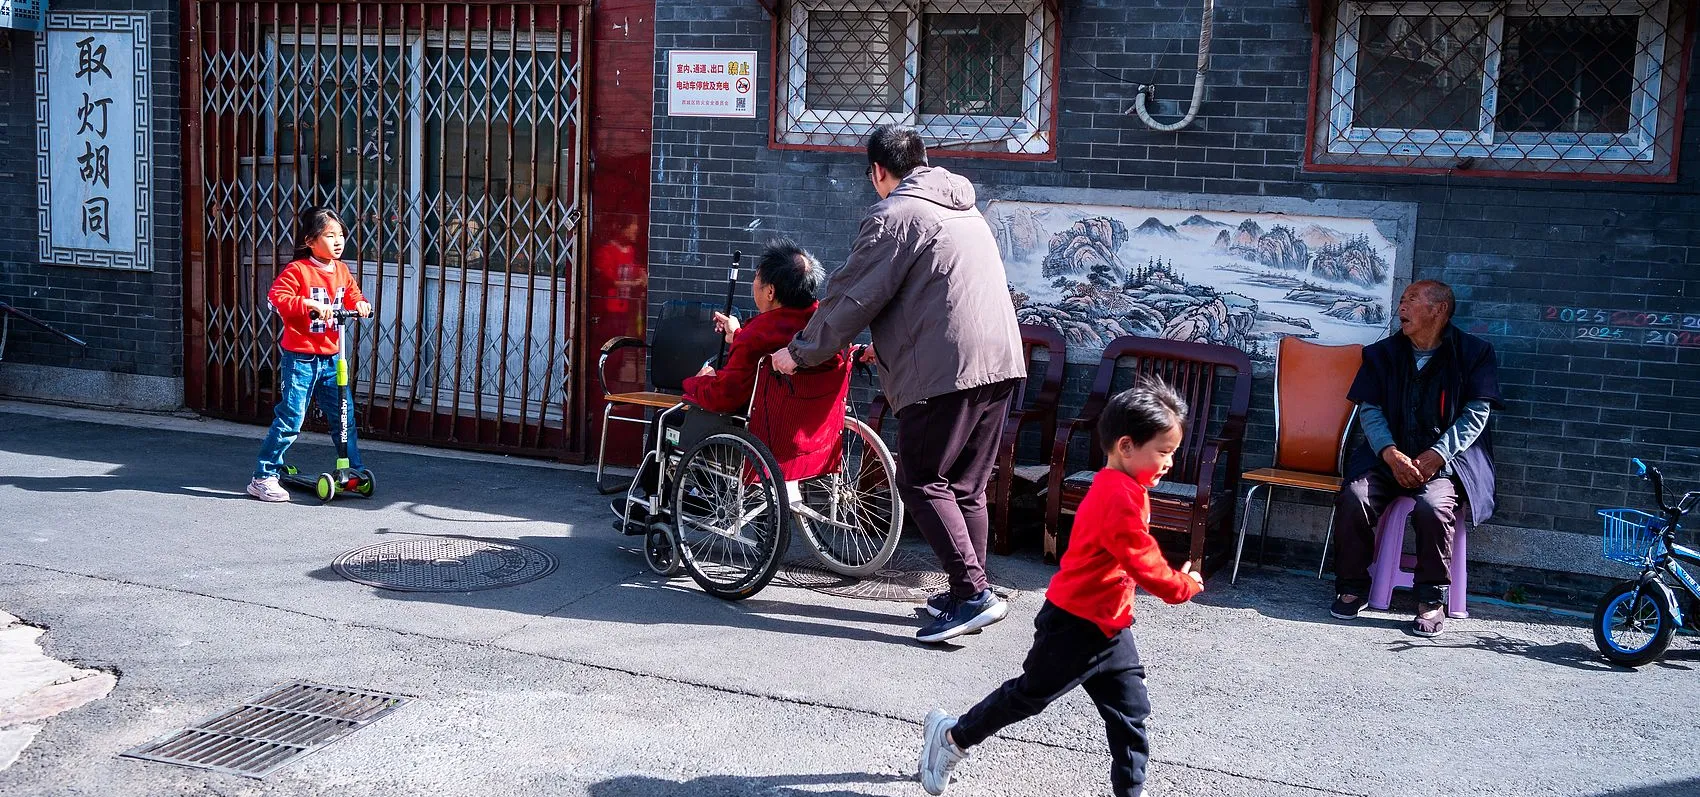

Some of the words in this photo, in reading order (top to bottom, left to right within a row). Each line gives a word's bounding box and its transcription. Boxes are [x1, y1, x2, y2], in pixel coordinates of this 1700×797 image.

[677, 64, 723, 73] 室内、通道、出口
[728, 61, 750, 76] 禁止
[677, 81, 730, 91] 电动车停放及充电
[75, 36, 113, 244] 取灯胡同
[1546, 307, 1607, 323] 2025
[1575, 326, 1624, 340] 2025
